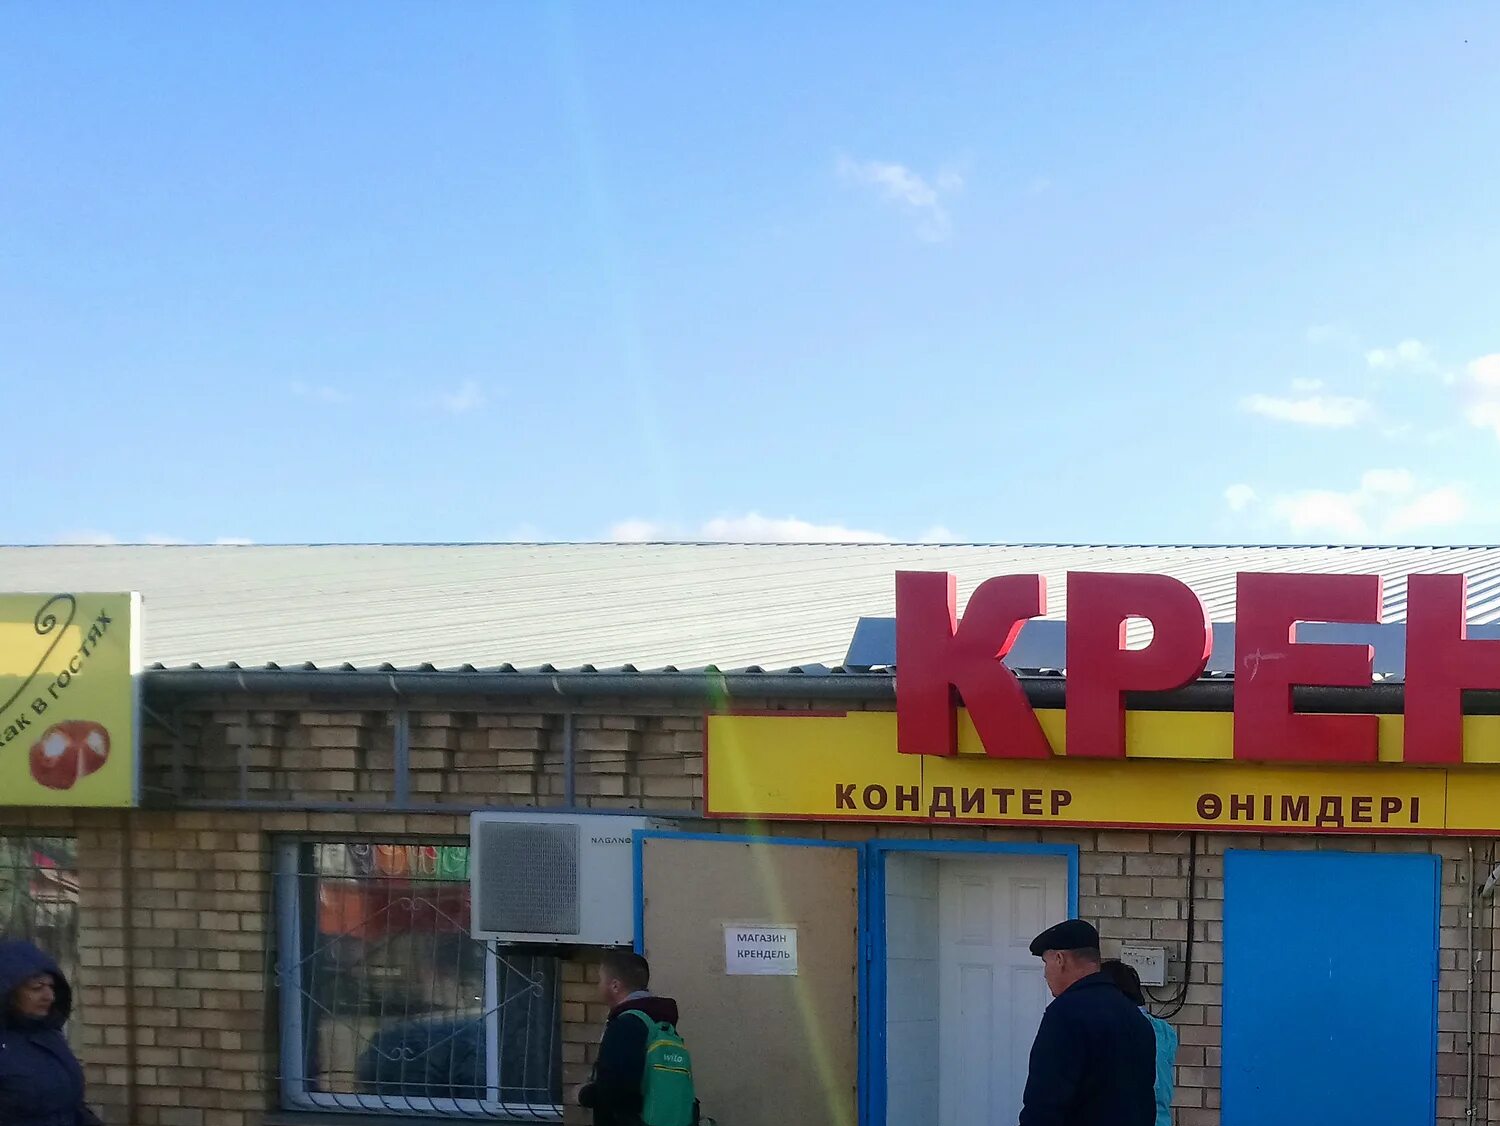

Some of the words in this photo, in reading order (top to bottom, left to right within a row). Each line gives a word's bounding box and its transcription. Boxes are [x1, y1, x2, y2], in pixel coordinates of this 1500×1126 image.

[835, 784, 1072, 817] КОНДИТЕР
[1196, 793, 1420, 827] ӨНІМДЕРІ
[737, 934, 787, 943] МАГАЗИН
[737, 950, 790, 960] КРЕНДЕЛЬ
